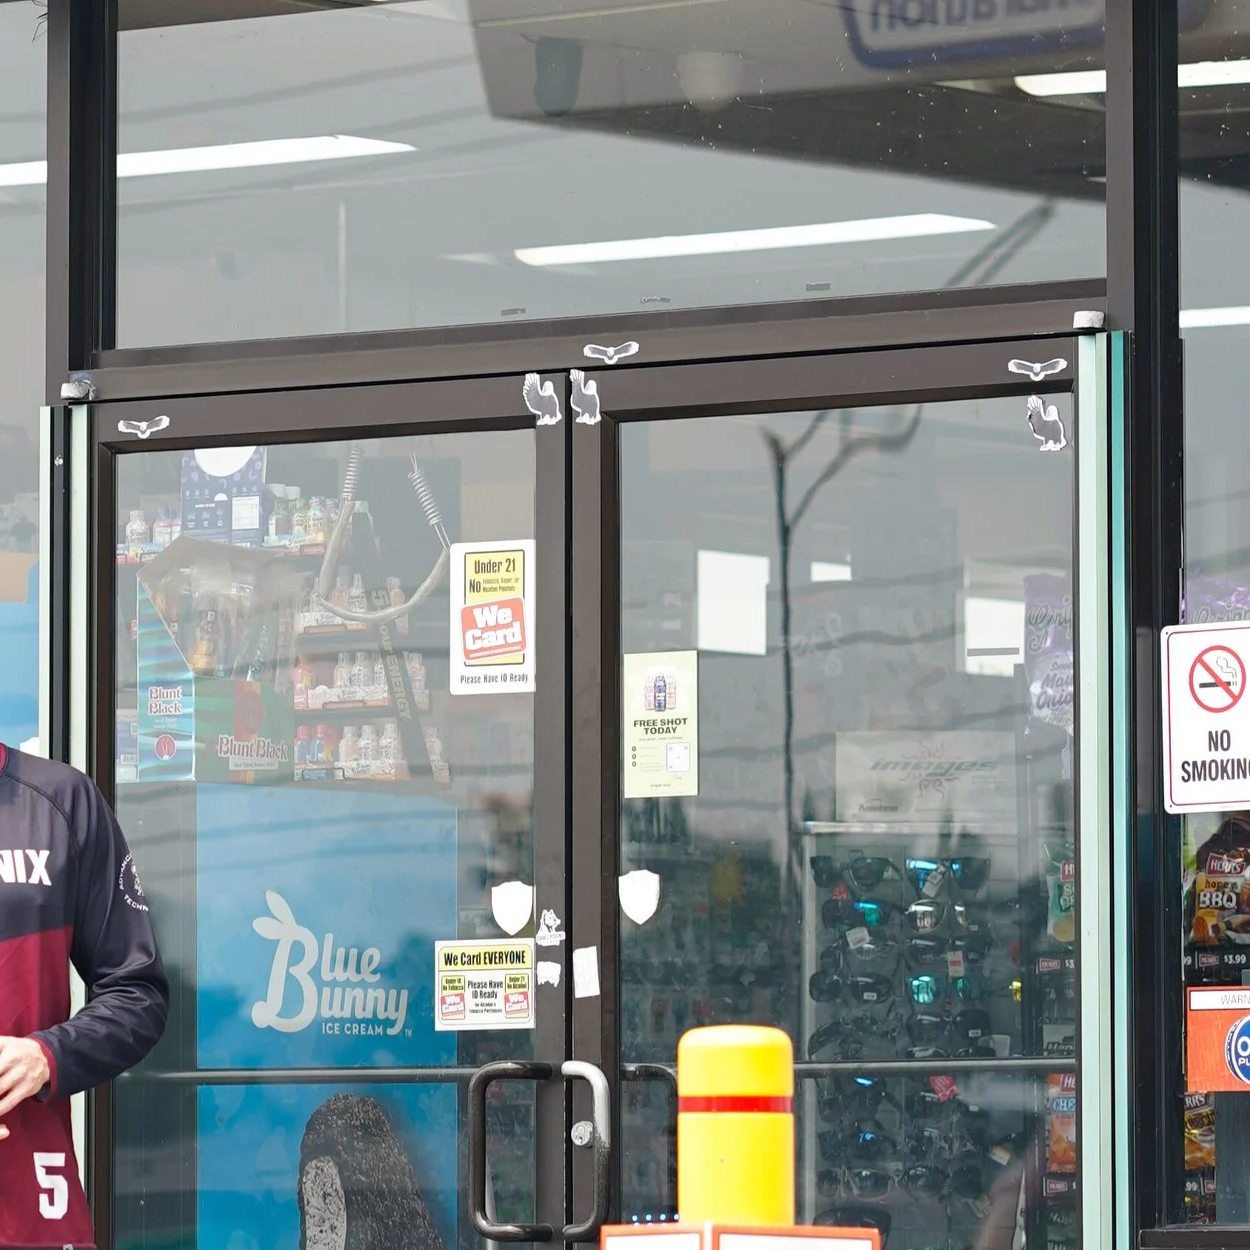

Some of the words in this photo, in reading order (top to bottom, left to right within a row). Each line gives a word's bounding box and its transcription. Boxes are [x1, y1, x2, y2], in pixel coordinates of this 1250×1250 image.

[474, 560, 502, 574] Under
[505, 558, 516, 573] 21
[469, 578, 481, 593] No
[472, 604, 513, 629] We
[465, 620, 522, 650] Card
[460, 674, 481, 684] Please
[484, 674, 498, 683] Have
[501, 674, 507, 683] ID
[509, 673, 528, 683] Ready
[148, 685, 182, 700] Blunt
[386, 653, 412, 720] ENERGY
[148, 701, 182, 716] Black
[633, 718, 658, 727] FREE
[660, 717, 688, 726] SHOT
[643, 726, 678, 735] TODAY
[218, 734, 255, 757] Blunt
[255, 737, 288, 761] Black
[1208, 730, 1231, 752] NO
[870, 758, 1001, 778] images
[1181, 757, 1250, 783] SMOKIN
[1210, 859, 1241, 873] HERR'S
[1198, 891, 1238, 909] BBQ
[444, 953, 458, 966] We
[460, 952, 481, 966] Card
[484, 950, 525, 965] EVERYONE
[1224, 955, 1247, 964] $3.99
[468, 980, 487, 989] Please
[489, 980, 503, 989] Have
[472, 990, 478, 999] ID
[480, 990, 498, 999] Ready
[322, 1022, 340, 1034] ICE
[344, 1023, 383, 1035] CREAM
[33, 1152, 69, 1220] 5
